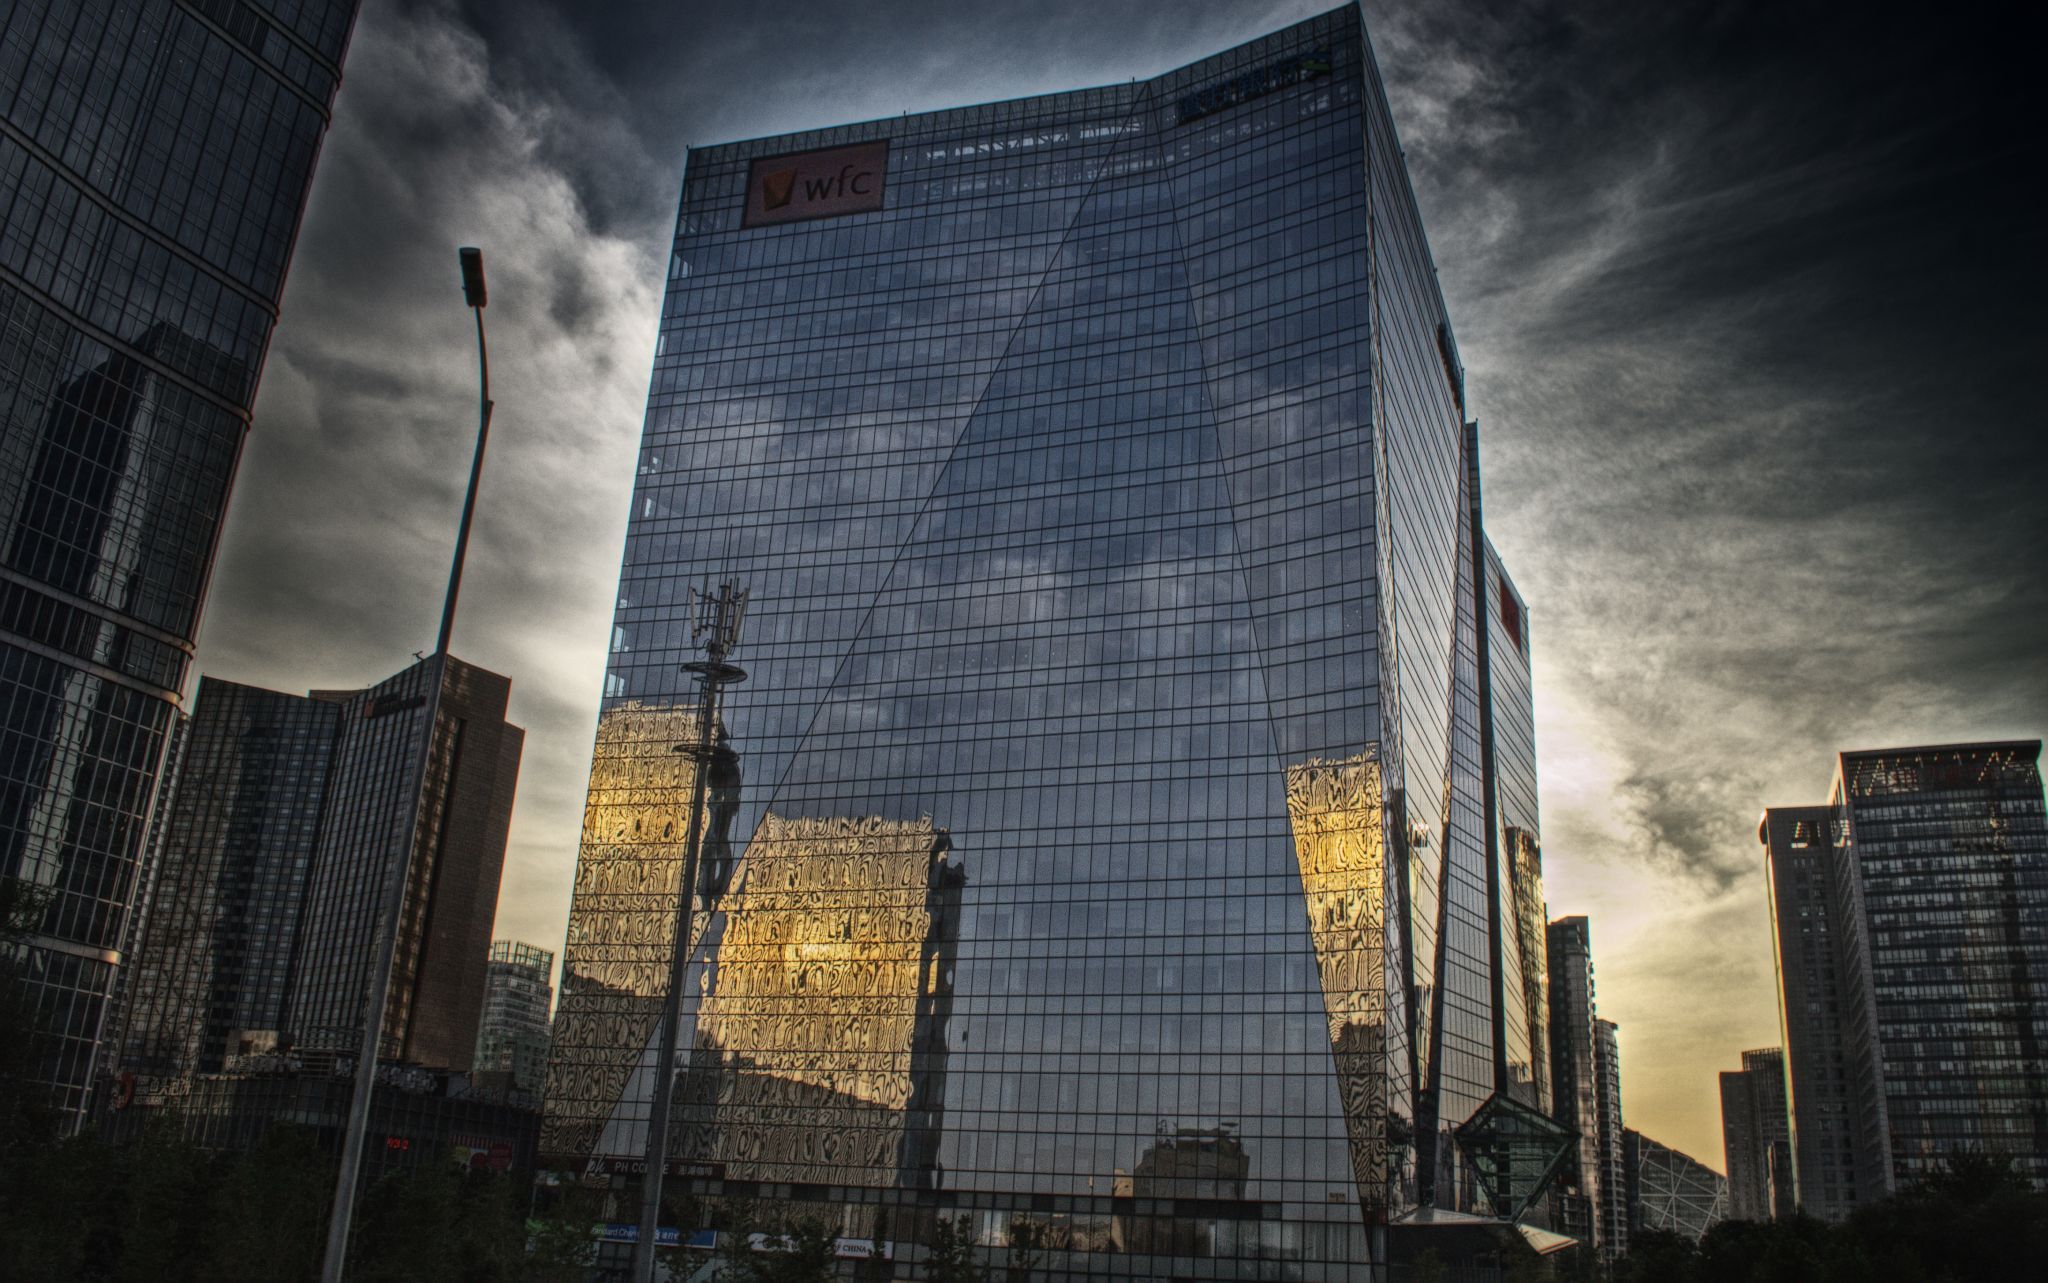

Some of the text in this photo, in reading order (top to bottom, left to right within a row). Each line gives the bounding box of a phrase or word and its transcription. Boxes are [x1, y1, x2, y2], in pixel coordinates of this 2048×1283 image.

[806, 164, 872, 201] wfc
[614, 1161, 629, 1173] PH
[843, 1244, 867, 1253] CHINA
